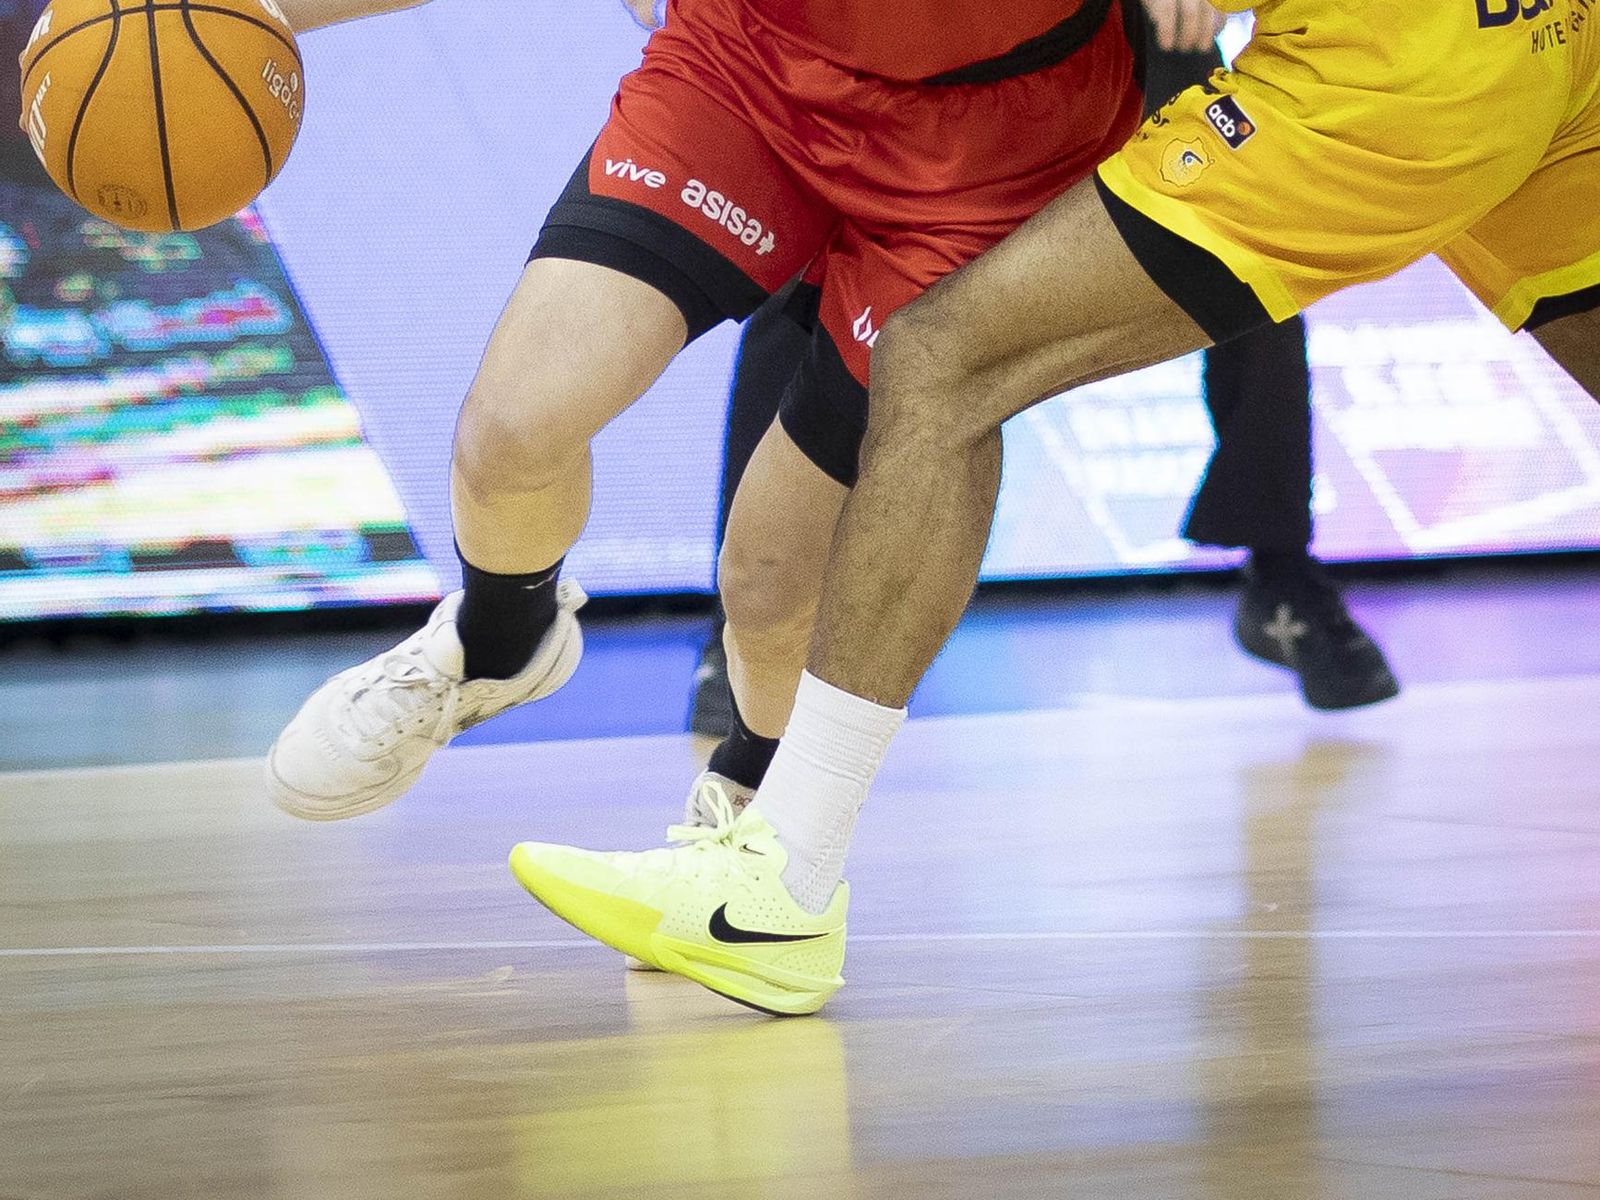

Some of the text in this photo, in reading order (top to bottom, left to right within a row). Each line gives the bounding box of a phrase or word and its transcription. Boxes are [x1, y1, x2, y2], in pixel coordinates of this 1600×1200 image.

[1531, 19, 1568, 54] HOTE
[1208, 104, 1236, 138] acb
[605, 159, 762, 246] vive asisa
